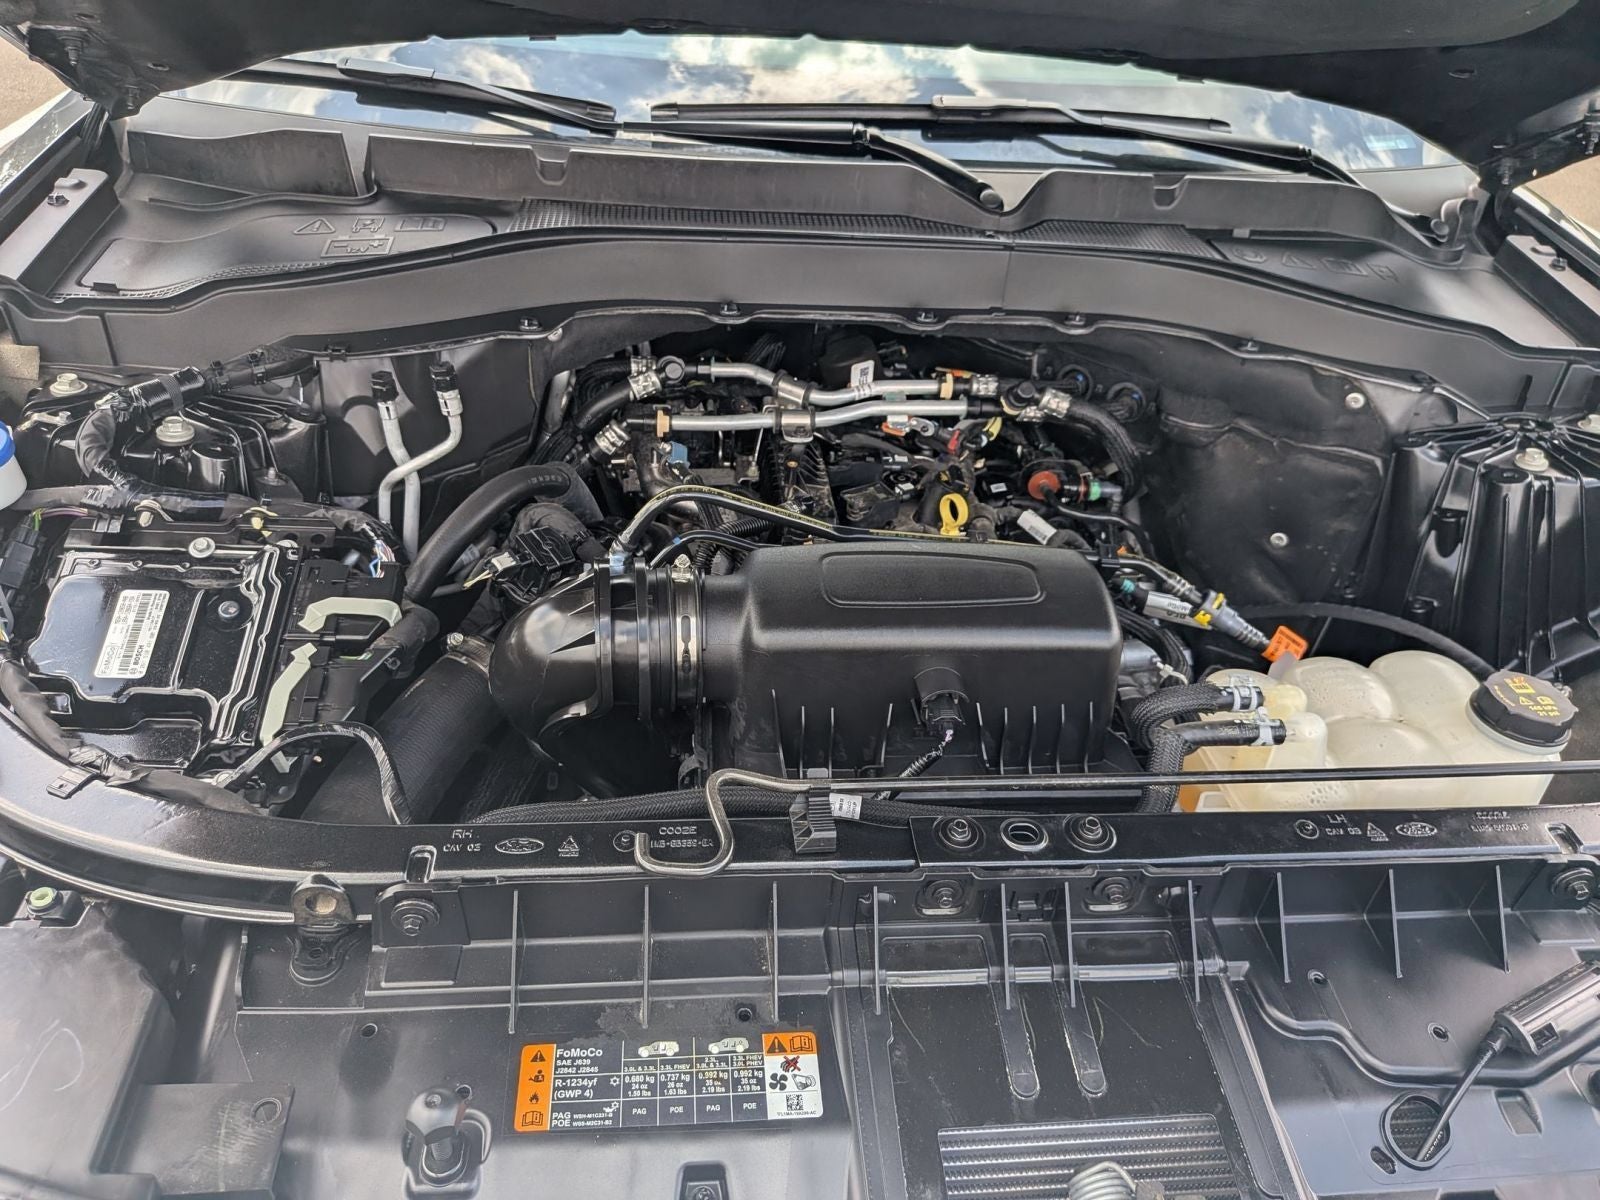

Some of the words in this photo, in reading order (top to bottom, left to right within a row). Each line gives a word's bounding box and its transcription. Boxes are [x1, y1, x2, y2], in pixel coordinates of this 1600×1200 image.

[133, 645, 145, 665] BOSCH
[1326, 814, 1348, 823] LH
[452, 829, 473, 839] RH
[556, 1048, 603, 1058] FoMoCo
[660, 1073, 679, 1082] 0.737
[680, 1073, 690, 1082] kg
[719, 1071, 729, 1079] kg
[753, 1069, 763, 1078] kg
[554, 1077, 598, 1088] R-1234yf
[645, 1075, 655, 1084] kg
[553, 1089, 582, 1101] (GWP
[583, 1088, 594, 1099] 4)
[669, 1106, 684, 1114] POE
[706, 1104, 721, 1112] PAG
[743, 1102, 757, 1110] POE
[632, 1107, 647, 1115] PAG
[551, 1112, 571, 1120] PAG
[551, 1119, 571, 1128] POE
